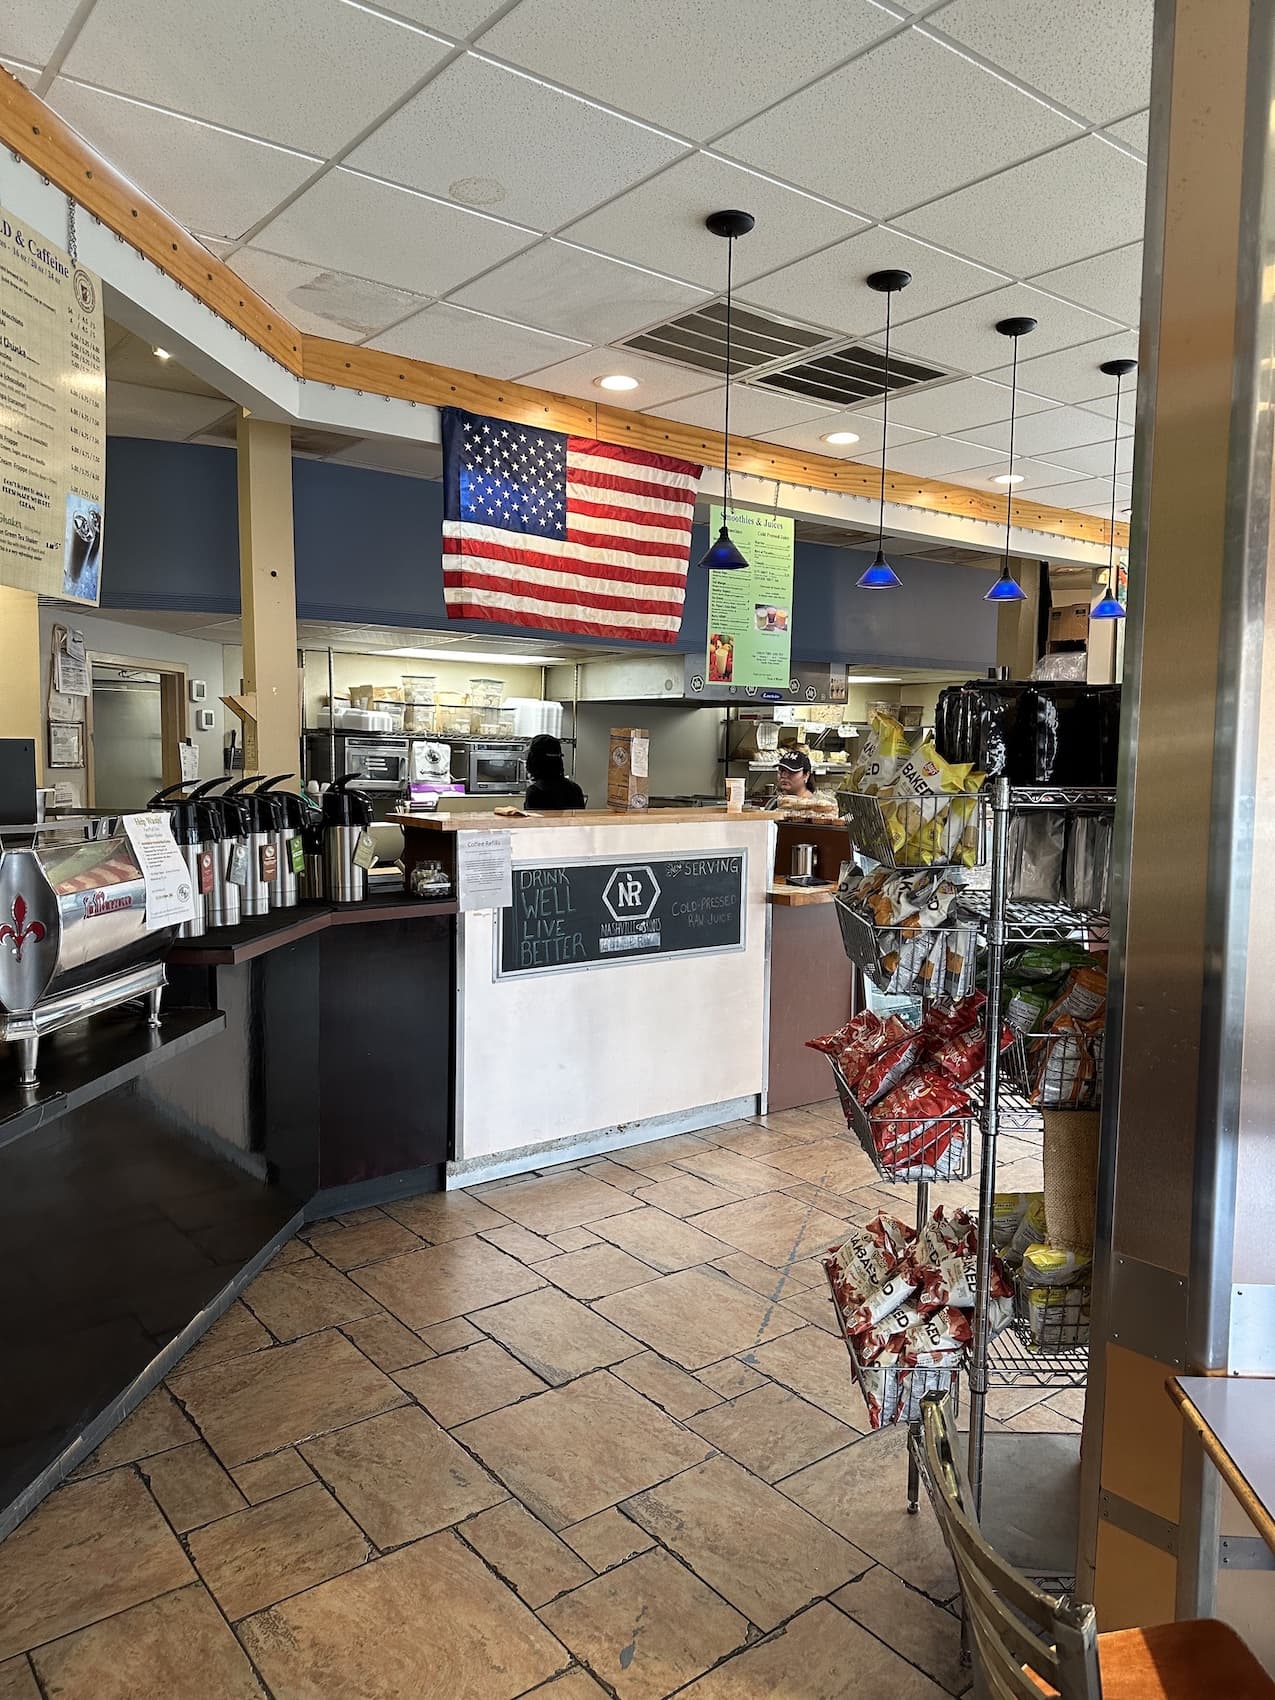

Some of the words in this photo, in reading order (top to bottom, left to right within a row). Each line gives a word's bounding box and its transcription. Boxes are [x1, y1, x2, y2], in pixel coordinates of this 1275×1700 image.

[16, 230, 25, 248] &
[28, 239, 69, 278] Caffeine
[756, 516, 762, 527] &
[764, 518, 784, 530] Juices
[520, 867, 570, 889] DRINK
[684, 858, 739, 876] SERVING
[522, 886, 576, 919] WELL
[524, 920, 565, 940] LIVE
[521, 932, 586, 966] BETTER
